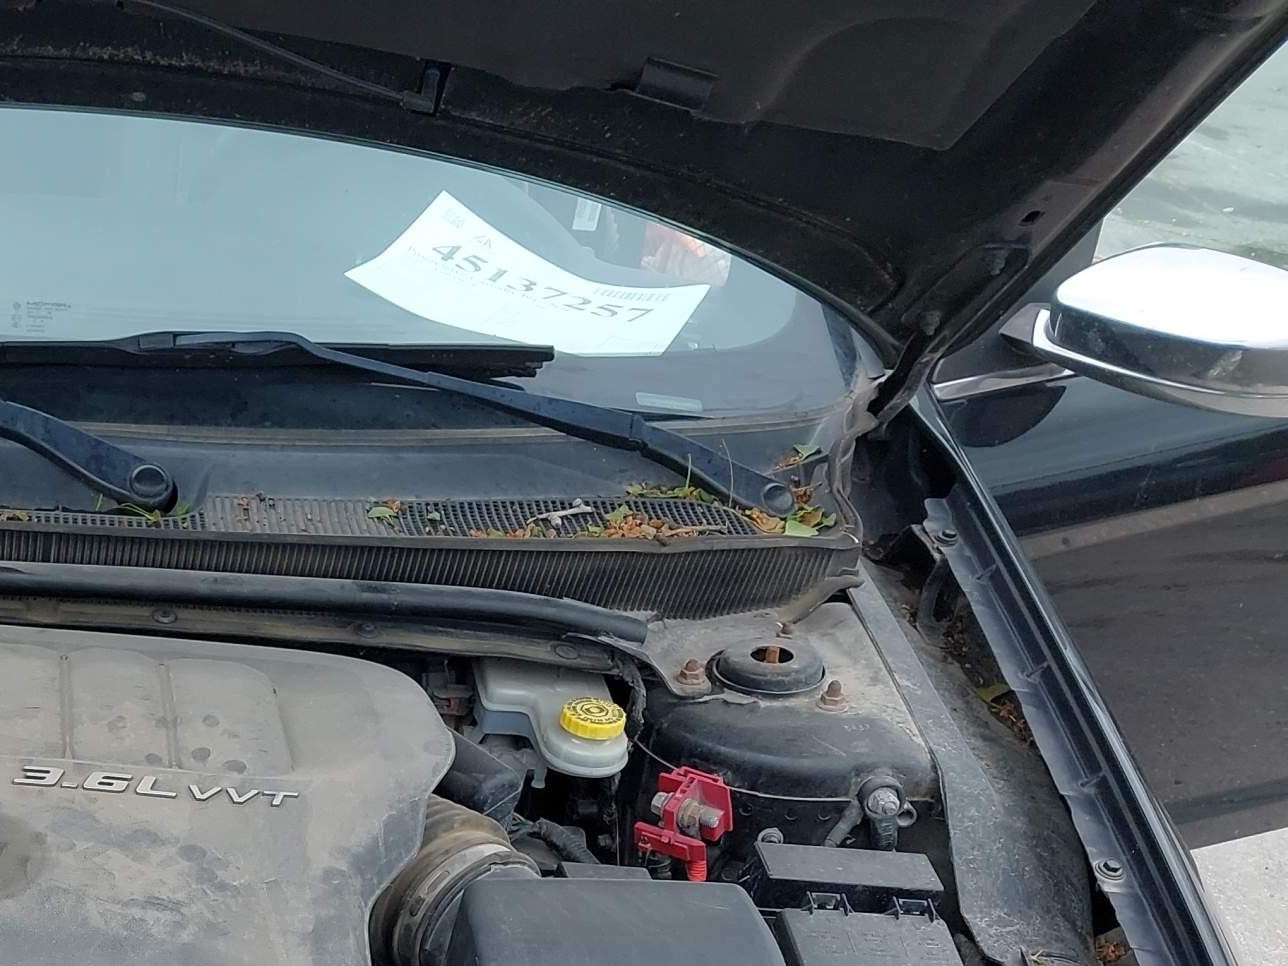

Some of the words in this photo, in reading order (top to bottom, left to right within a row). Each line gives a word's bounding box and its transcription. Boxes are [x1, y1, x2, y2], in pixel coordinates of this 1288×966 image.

[431, 243, 655, 323] 45137257
[12, 765, 177, 798] 3.6L
[188, 784, 299, 807] VVT
